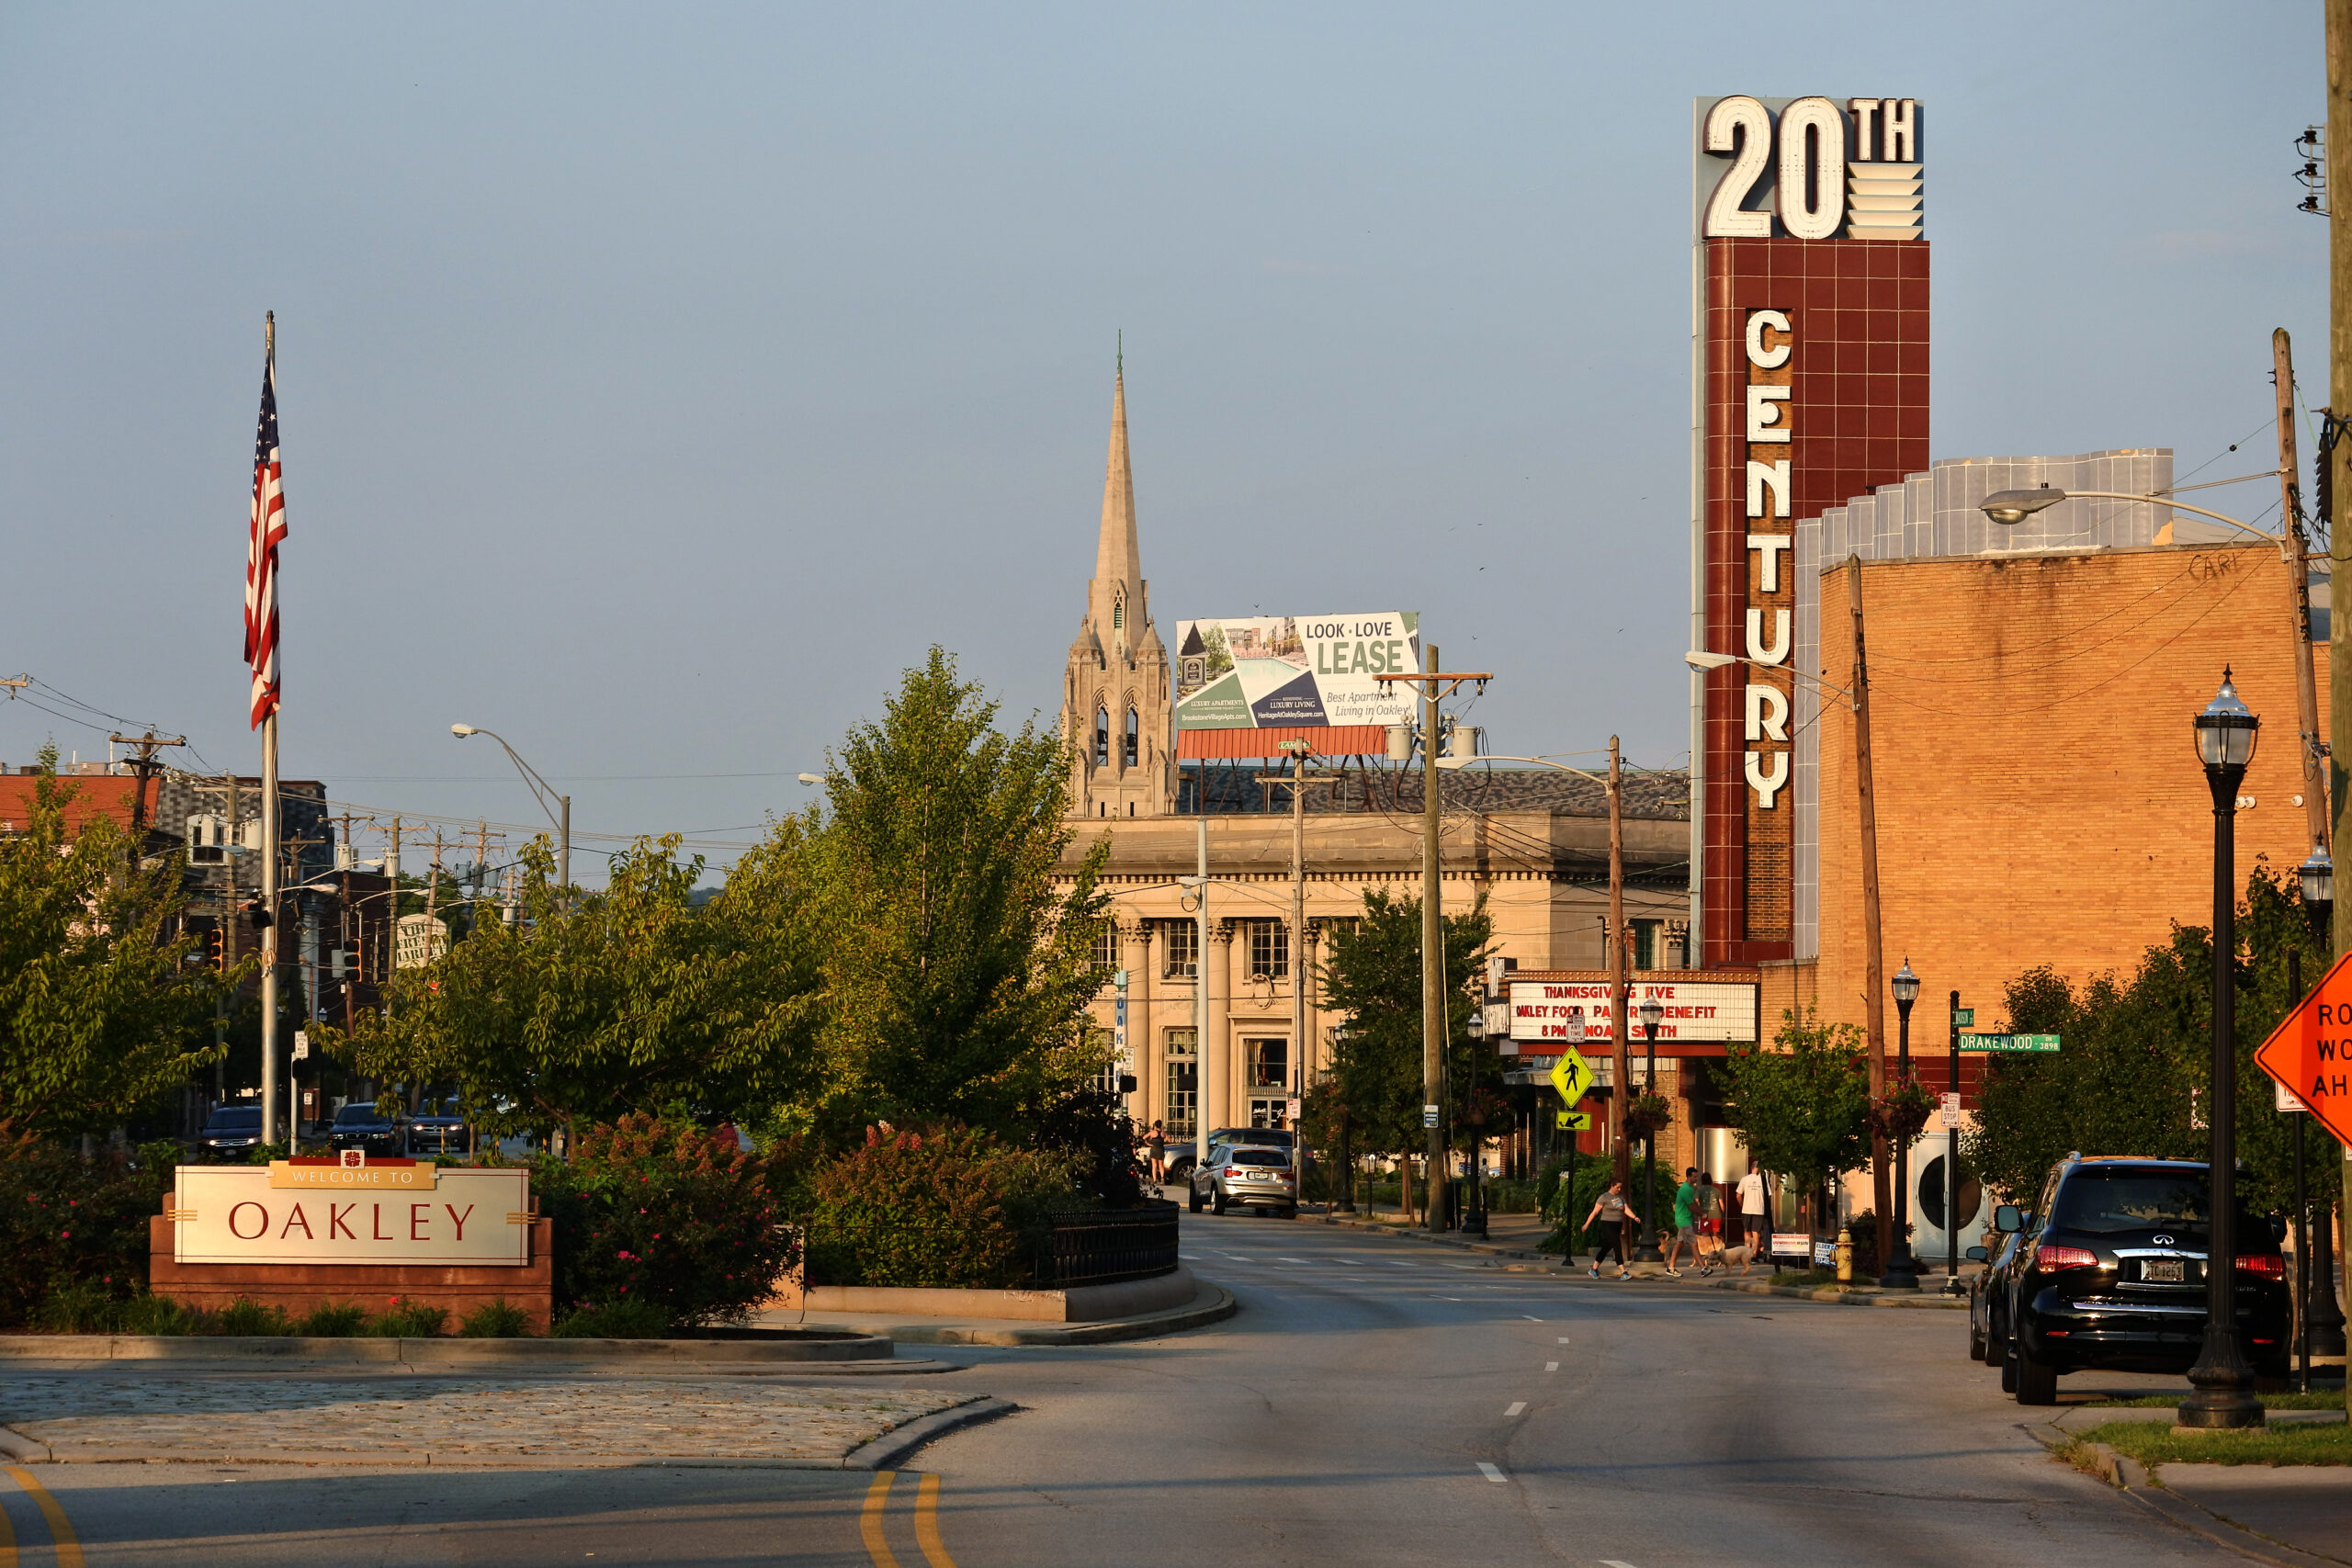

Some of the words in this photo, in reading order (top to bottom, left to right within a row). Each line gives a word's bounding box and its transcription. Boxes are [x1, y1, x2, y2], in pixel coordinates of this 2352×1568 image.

[1702, 95, 1916, 240] 20TH
[1746, 310, 1792, 808] CENTURY
[1306, 623, 1345, 638] LOOK
[1355, 622, 1392, 637] LOVE
[1317, 640, 1403, 674] LEASE
[1327, 693, 1346, 703] Best
[1348, 692, 1396, 704] Apartment
[1335, 705, 1364, 717] Living
[1365, 706, 1374, 716] in
[1376, 705, 1411, 716] Oakley!
[1544, 987, 1635, 998] THANKSGIVG
[1517, 1005, 1548, 1017] OAKLEY
[1553, 1006, 1584, 1017] FOOD
[1542, 1025, 1548, 1036] 8
[1552, 1025, 1566, 1036] PM
[1586, 1025, 1613, 1036] NOA
[1961, 1036, 2032, 1049] DRAKEWOOD
[292, 1171, 380, 1183] WELCOME
[390, 1172, 413, 1184] TO
[229, 1201, 475, 1241] OAKLEY
